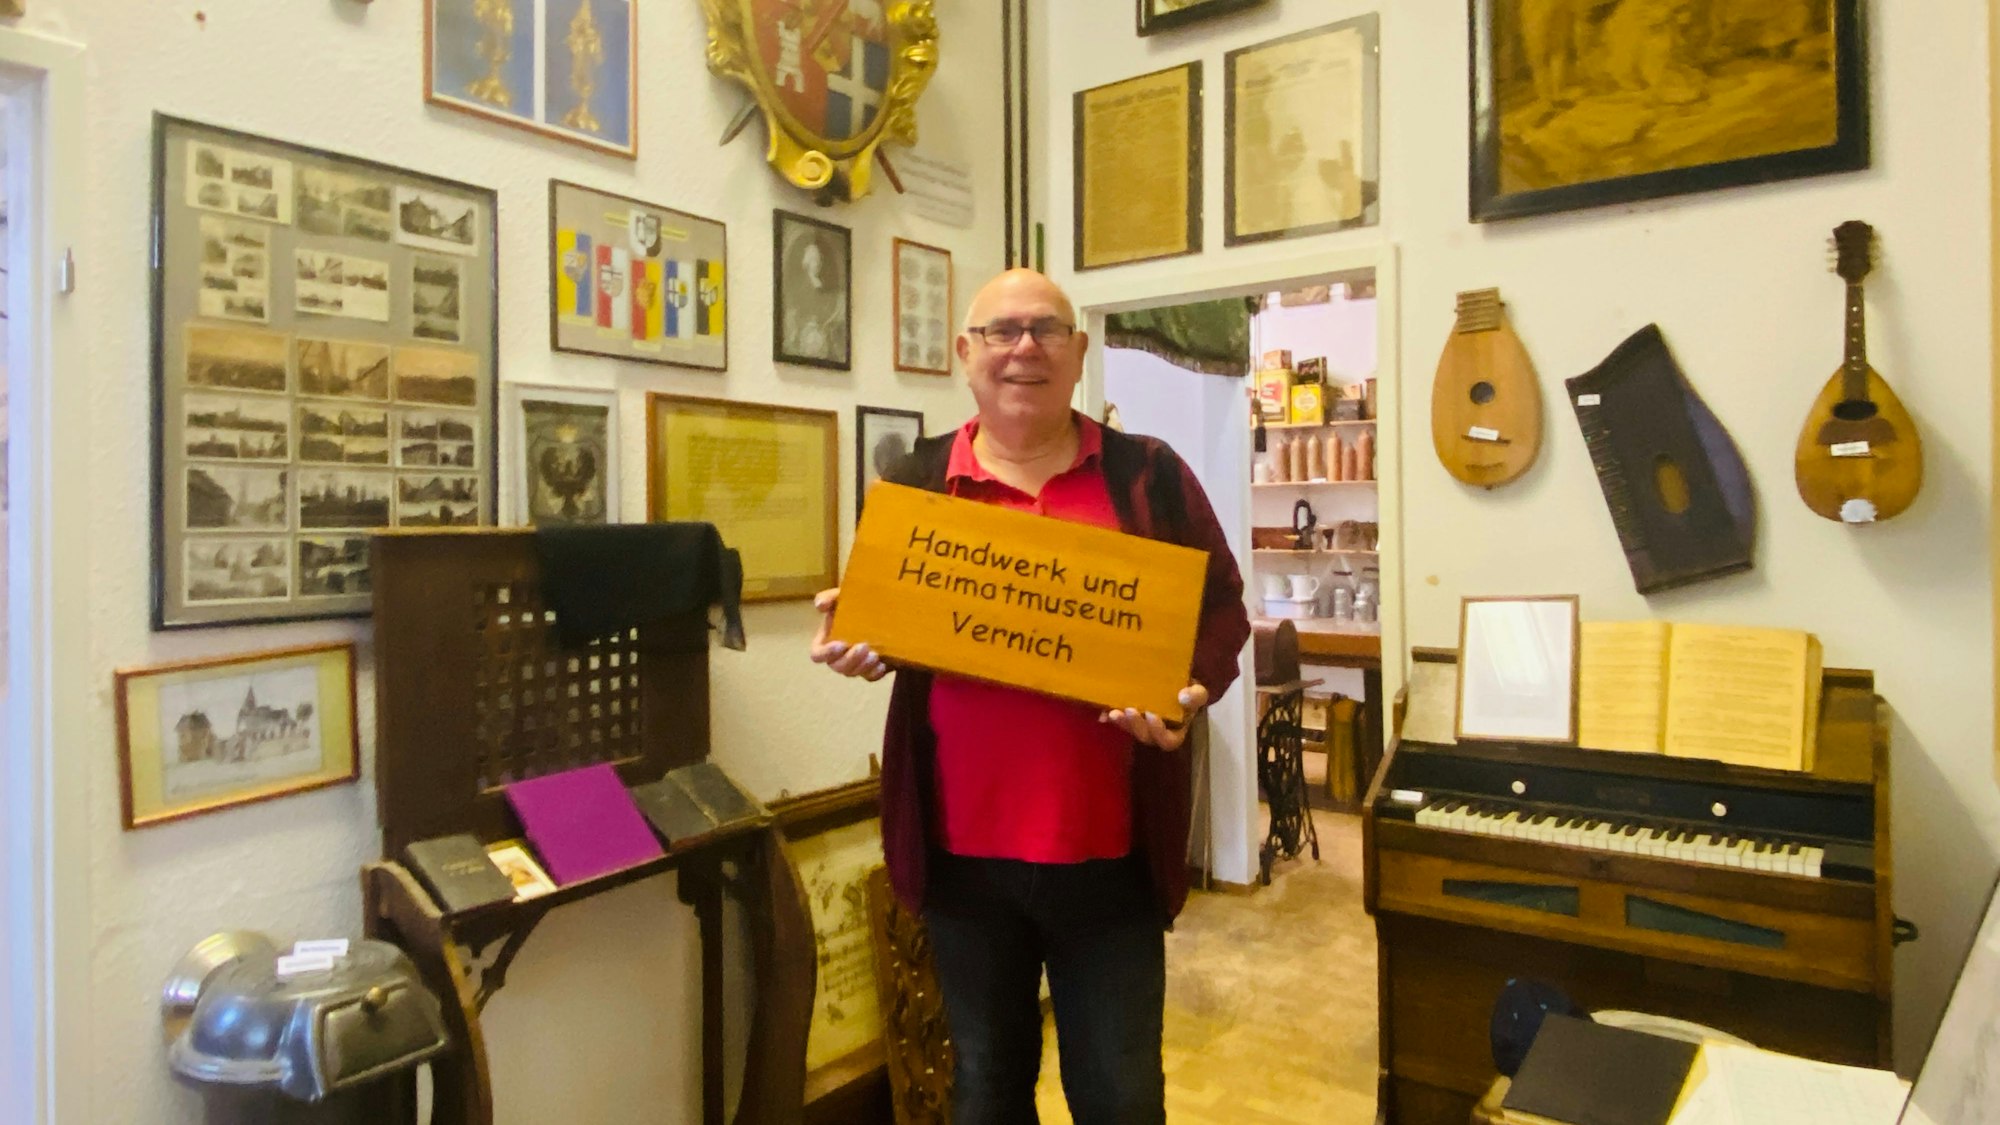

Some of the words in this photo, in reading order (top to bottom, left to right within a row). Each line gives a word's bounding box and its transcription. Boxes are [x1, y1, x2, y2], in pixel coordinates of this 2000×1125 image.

[898, 557, 1143, 632] Heimatmuseum
[908, 525, 1067, 584] Handwerk
[1083, 575, 1141, 602] und
[952, 611, 1074, 663] Vernich
